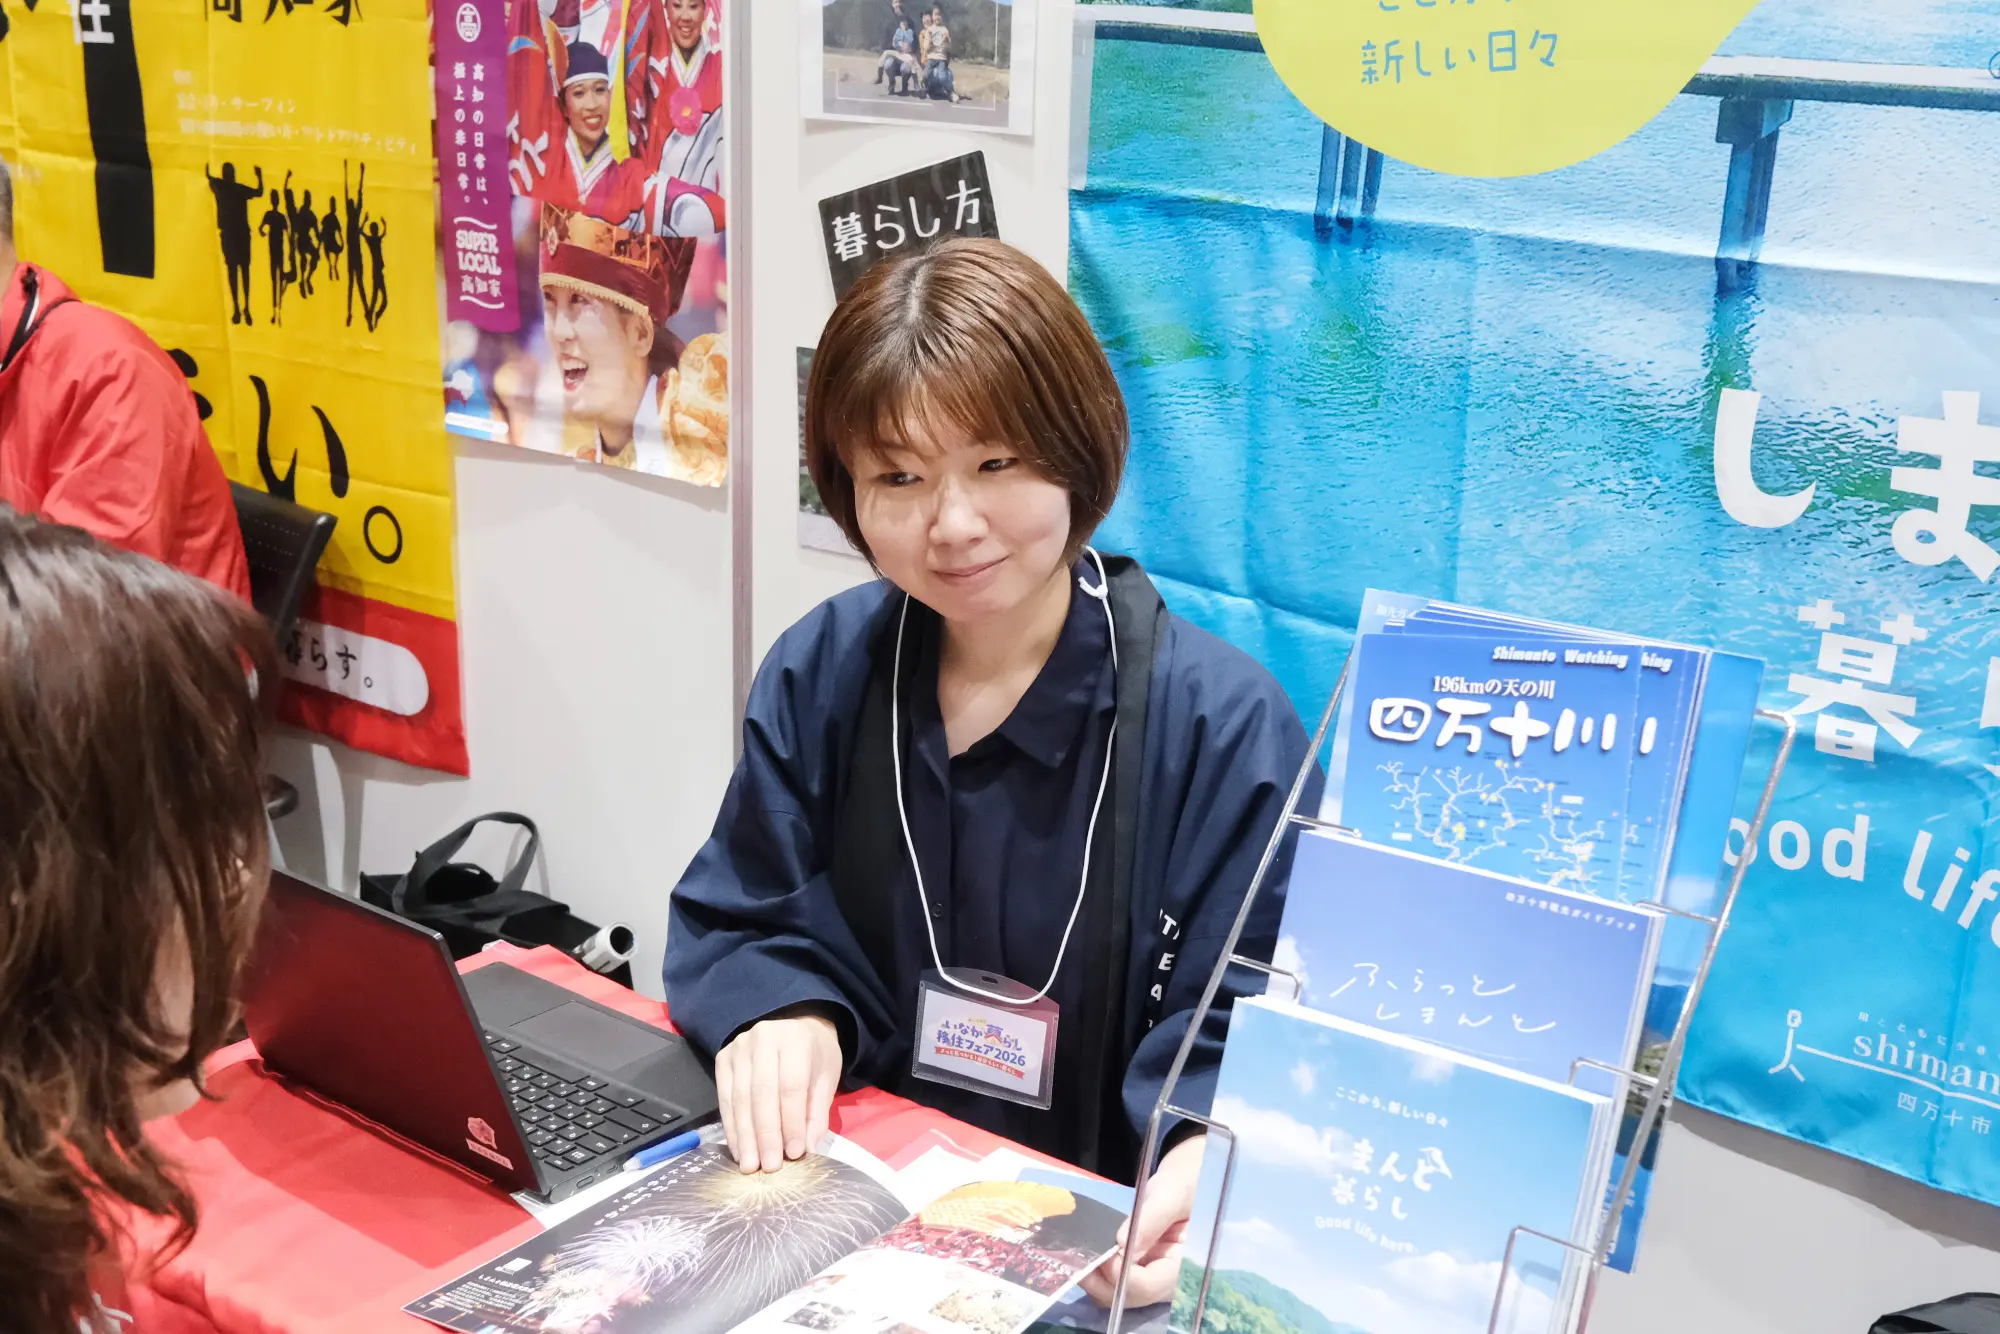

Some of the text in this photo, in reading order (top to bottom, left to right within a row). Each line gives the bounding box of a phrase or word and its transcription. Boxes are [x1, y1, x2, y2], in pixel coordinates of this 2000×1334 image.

[1361, 30, 1558, 84] 新しい日々
[831, 179, 981, 261] 暮らし方
[456, 229, 499, 254] SUPER
[457, 251, 502, 275] LOCAL
[461, 274, 502, 297] 高知家
[1713, 387, 2000, 583] しま
[1492, 645, 1629, 669] Shimanto Watching
[1432, 675, 1556, 700] 196kmの天の川
[1369, 697, 1617, 757] 四万十川
[1903, 829, 2000, 949] lif
[1329, 962, 1516, 998] ふらっと
[942, 1020, 1022, 1052] いなか暮らし
[1376, 1003, 1557, 1034] しまんと
[937, 1029, 1026, 1067] 移住フェア2026
[1335, 1085, 1449, 1128] ここから、新しい日々
[1897, 1091, 1992, 1135] 四万十市
[1331, 1173, 1409, 1221] 暮らし
[1315, 1215, 1351, 1231] Good
[1354, 1220, 1378, 1243] life
